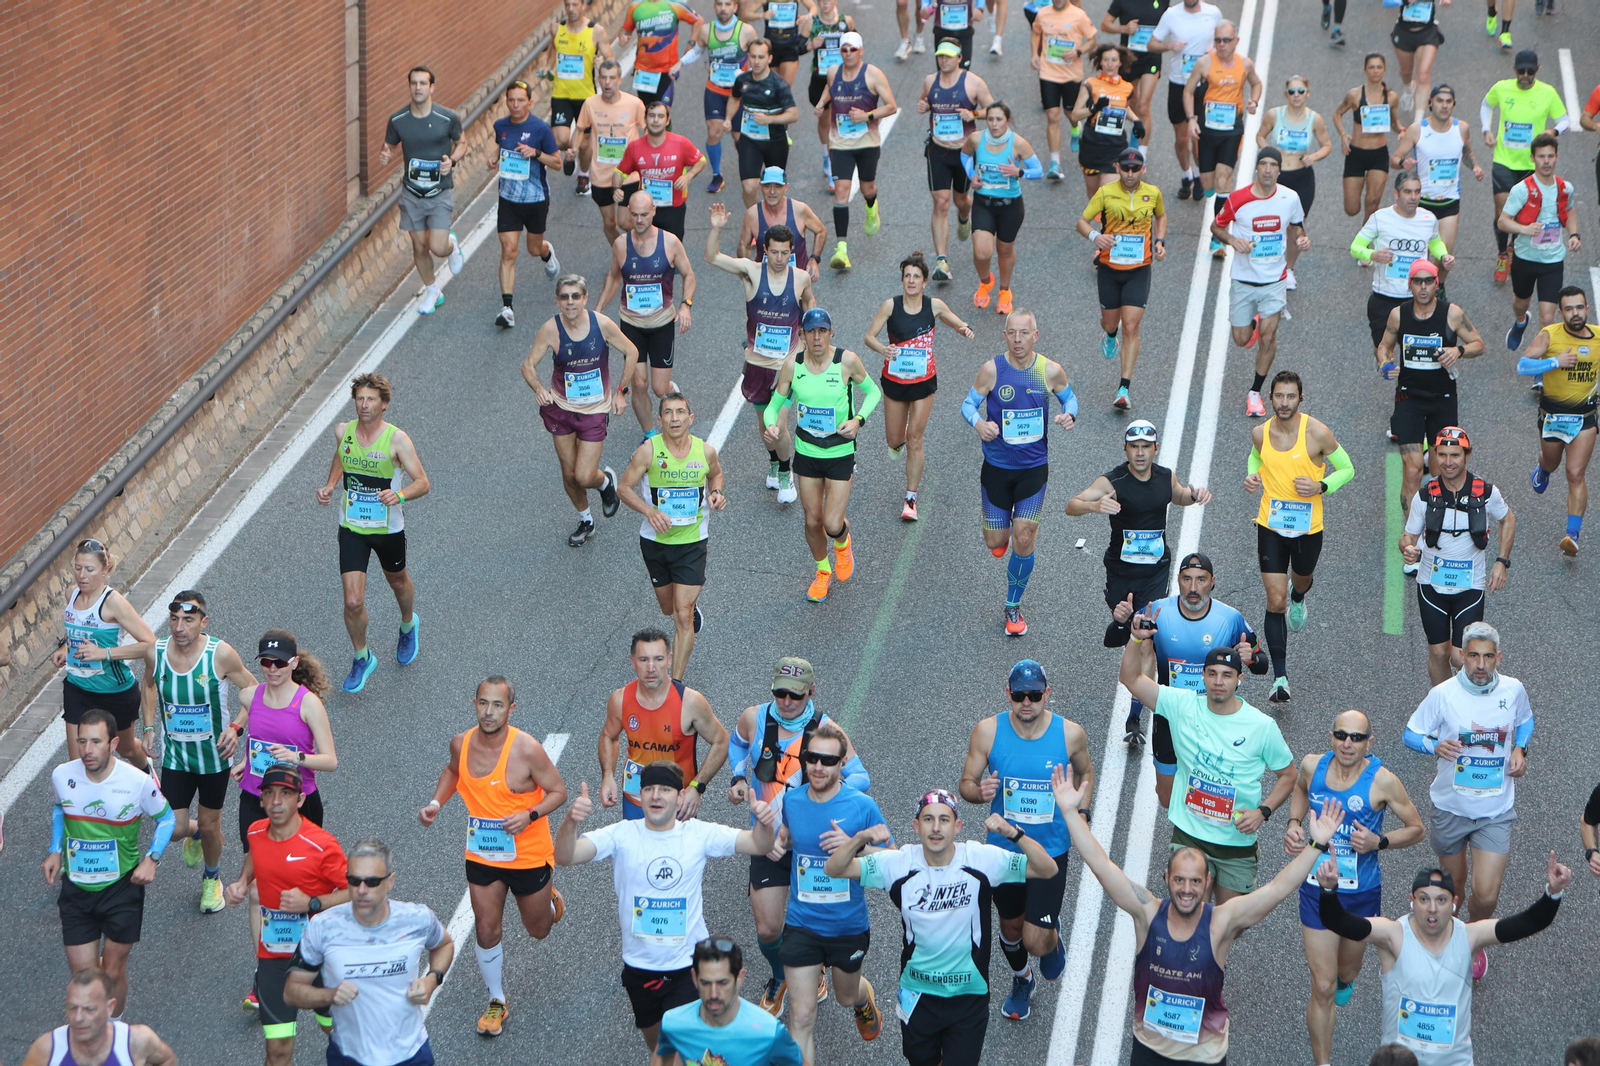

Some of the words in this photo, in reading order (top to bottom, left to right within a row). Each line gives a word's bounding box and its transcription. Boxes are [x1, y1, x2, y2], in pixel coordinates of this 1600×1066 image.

[342, 454, 379, 469] melgar
[660, 470, 699, 480] melgar
[780, 665, 804, 677] SF
[1470, 732, 1499, 743] CAMPER
[643, 742, 680, 752] CAMAS
[1202, 784, 1229, 795] ZURICH
[1201, 797, 1216, 808] 1025
[1187, 801, 1204, 813] ABDIEL
[1205, 807, 1229, 819] ESTEBAN
[481, 821, 504, 829] ZURIC
[934, 882, 967, 900] INTER
[928, 893, 971, 911] RUNNERS
[909, 968, 930, 983] INTER
[932, 973, 972, 983] CROSSFIT
[1150, 963, 1184, 976] PÉGATE
[1186, 971, 1202, 979] AHÍ
[1165, 996, 1196, 1007] ZURICH
[1163, 1011, 1181, 1019] 4587
[1419, 1005, 1450, 1015] ZURICH
[1157, 1019, 1184, 1030] ROBERTO
[1416, 1022, 1435, 1031] 4855
[1416, 1032, 1432, 1041] RAUL
